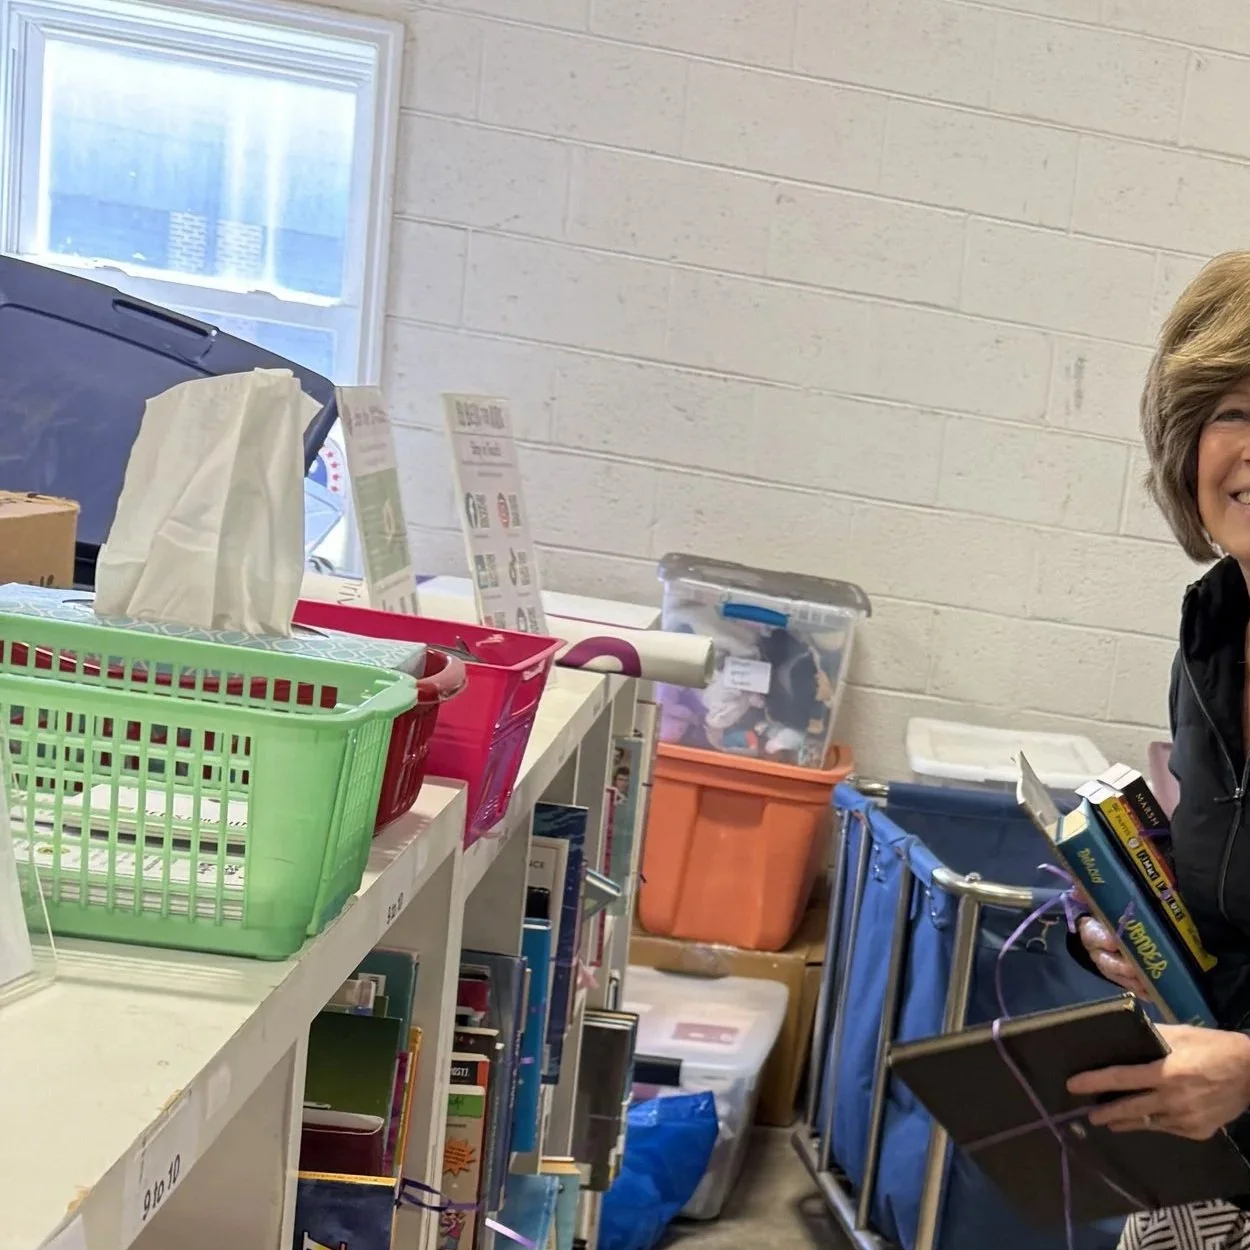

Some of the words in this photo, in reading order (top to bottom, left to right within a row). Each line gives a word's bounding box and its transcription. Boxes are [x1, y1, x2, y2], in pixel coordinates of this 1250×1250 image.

[1135, 792, 1159, 827] MARSH
[143, 1189, 151, 1221] 9
[153, 1181, 164, 1208] to
[168, 1154, 180, 1190] 10
